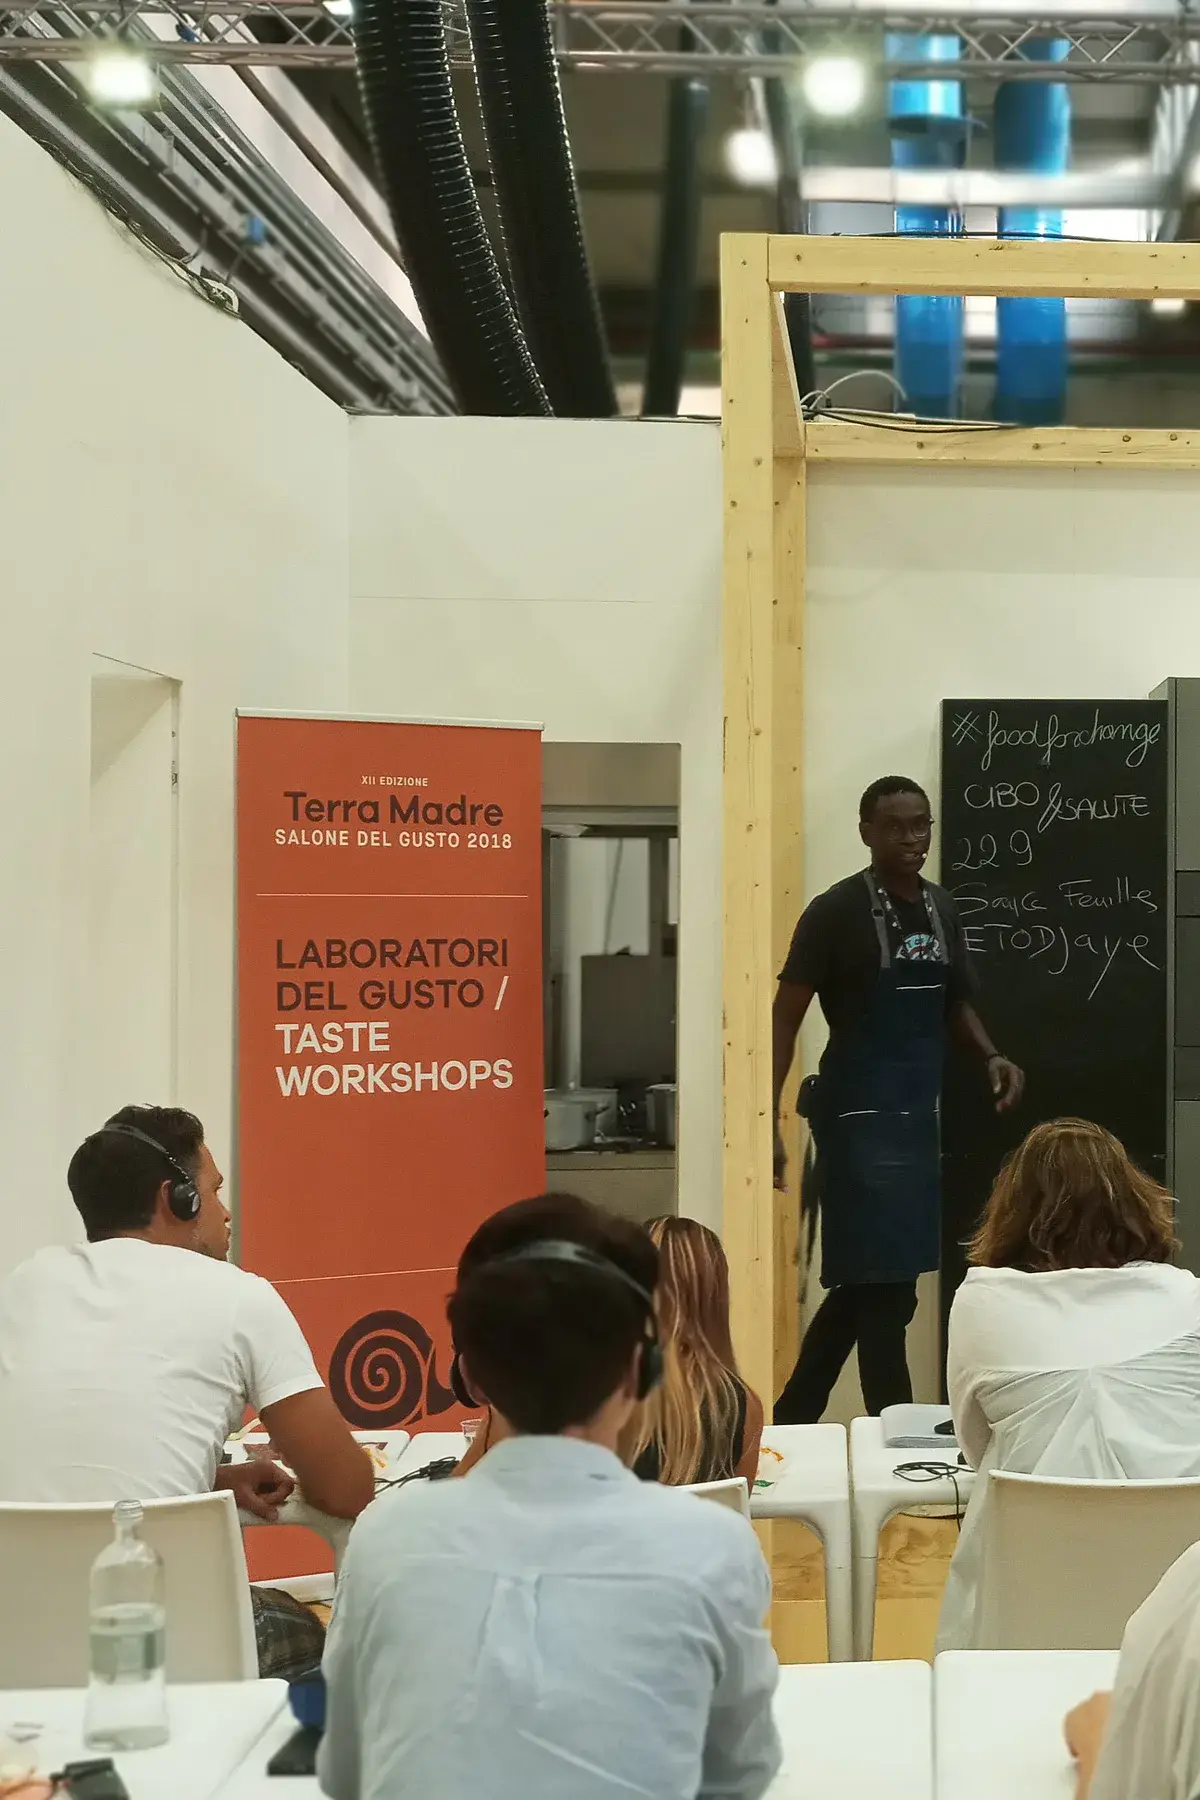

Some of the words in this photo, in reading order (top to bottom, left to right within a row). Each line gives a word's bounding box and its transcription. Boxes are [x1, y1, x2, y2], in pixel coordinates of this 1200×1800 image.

[361, 775, 376, 786] XII
[380, 776, 429, 787] EDIZIONE
[283, 791, 380, 824] Terra
[390, 794, 504, 827] Madre
[275, 828, 349, 846] SALONE
[357, 831, 392, 847] DEL
[399, 831, 460, 848] GUSTO
[467, 833, 512, 849] 2018
[276, 938, 509, 970] LABORATORI
[276, 981, 347, 1012] DEL
[359, 979, 484, 1010] GUSTO
[275, 1021, 391, 1054] TASTE
[275, 1059, 514, 1097] WORKSHOPS
